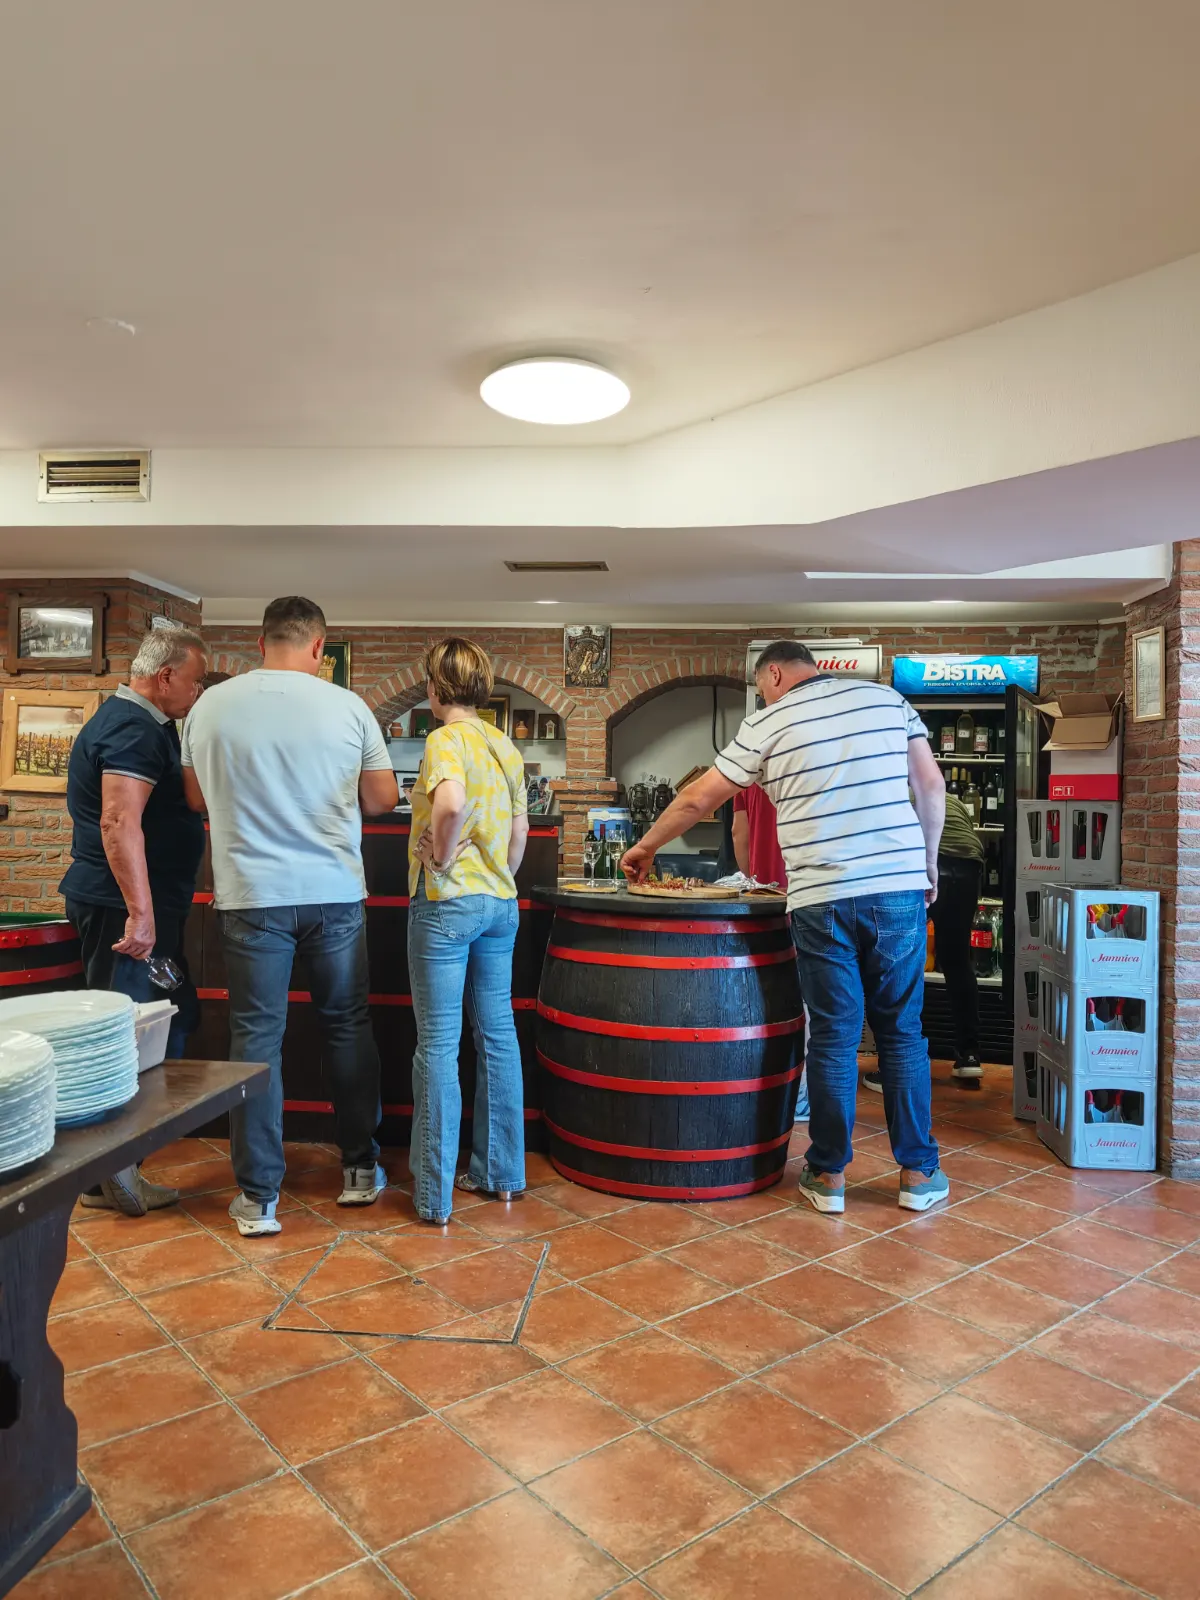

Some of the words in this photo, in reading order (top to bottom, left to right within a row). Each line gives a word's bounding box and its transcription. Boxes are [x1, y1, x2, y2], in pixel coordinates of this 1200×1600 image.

[816, 656, 859, 670] nica
[922, 660, 1006, 681] BISTRA
[1092, 953, 1140, 963] Jamnica
[1091, 1045, 1139, 1056] Jamnica
[1090, 1138, 1137, 1148] Jamnica
